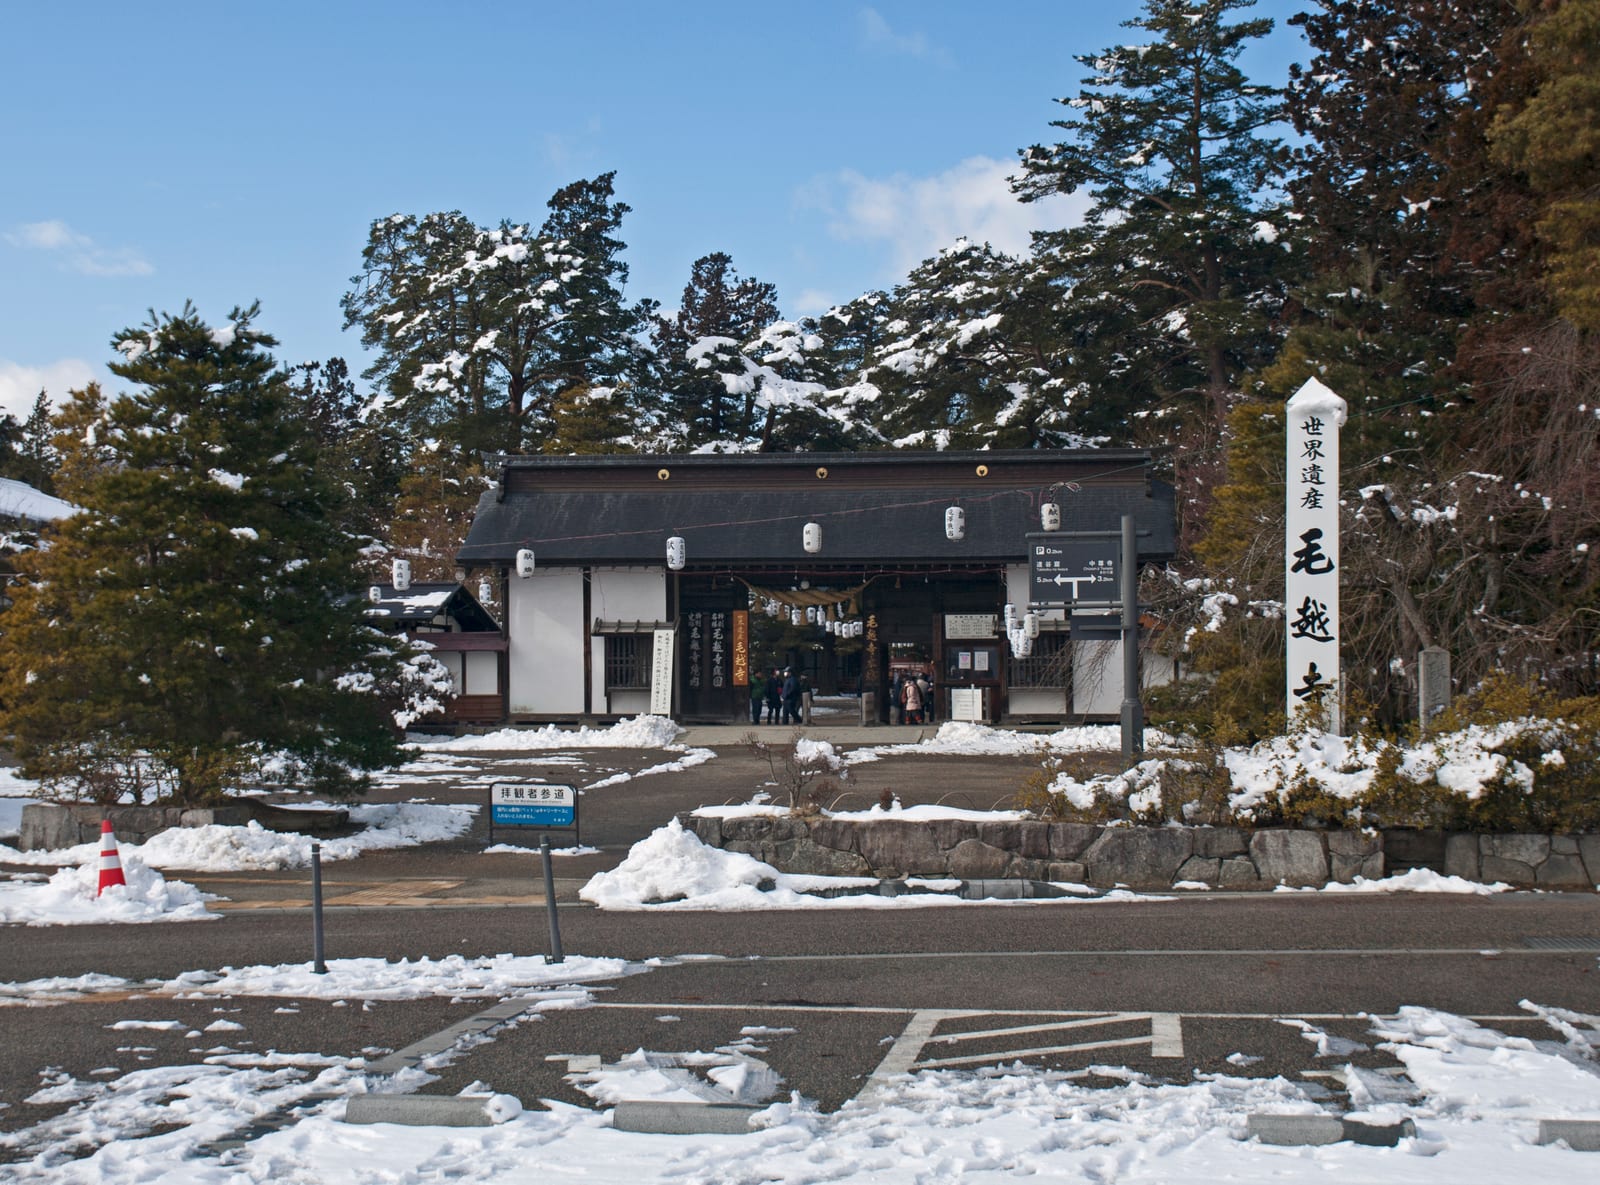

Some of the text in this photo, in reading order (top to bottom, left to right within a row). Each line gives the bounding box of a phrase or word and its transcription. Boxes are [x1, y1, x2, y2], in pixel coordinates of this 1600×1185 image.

[1300, 415, 1325, 510] 世界遺産
[501, 787, 565, 800] 拝観者参道
